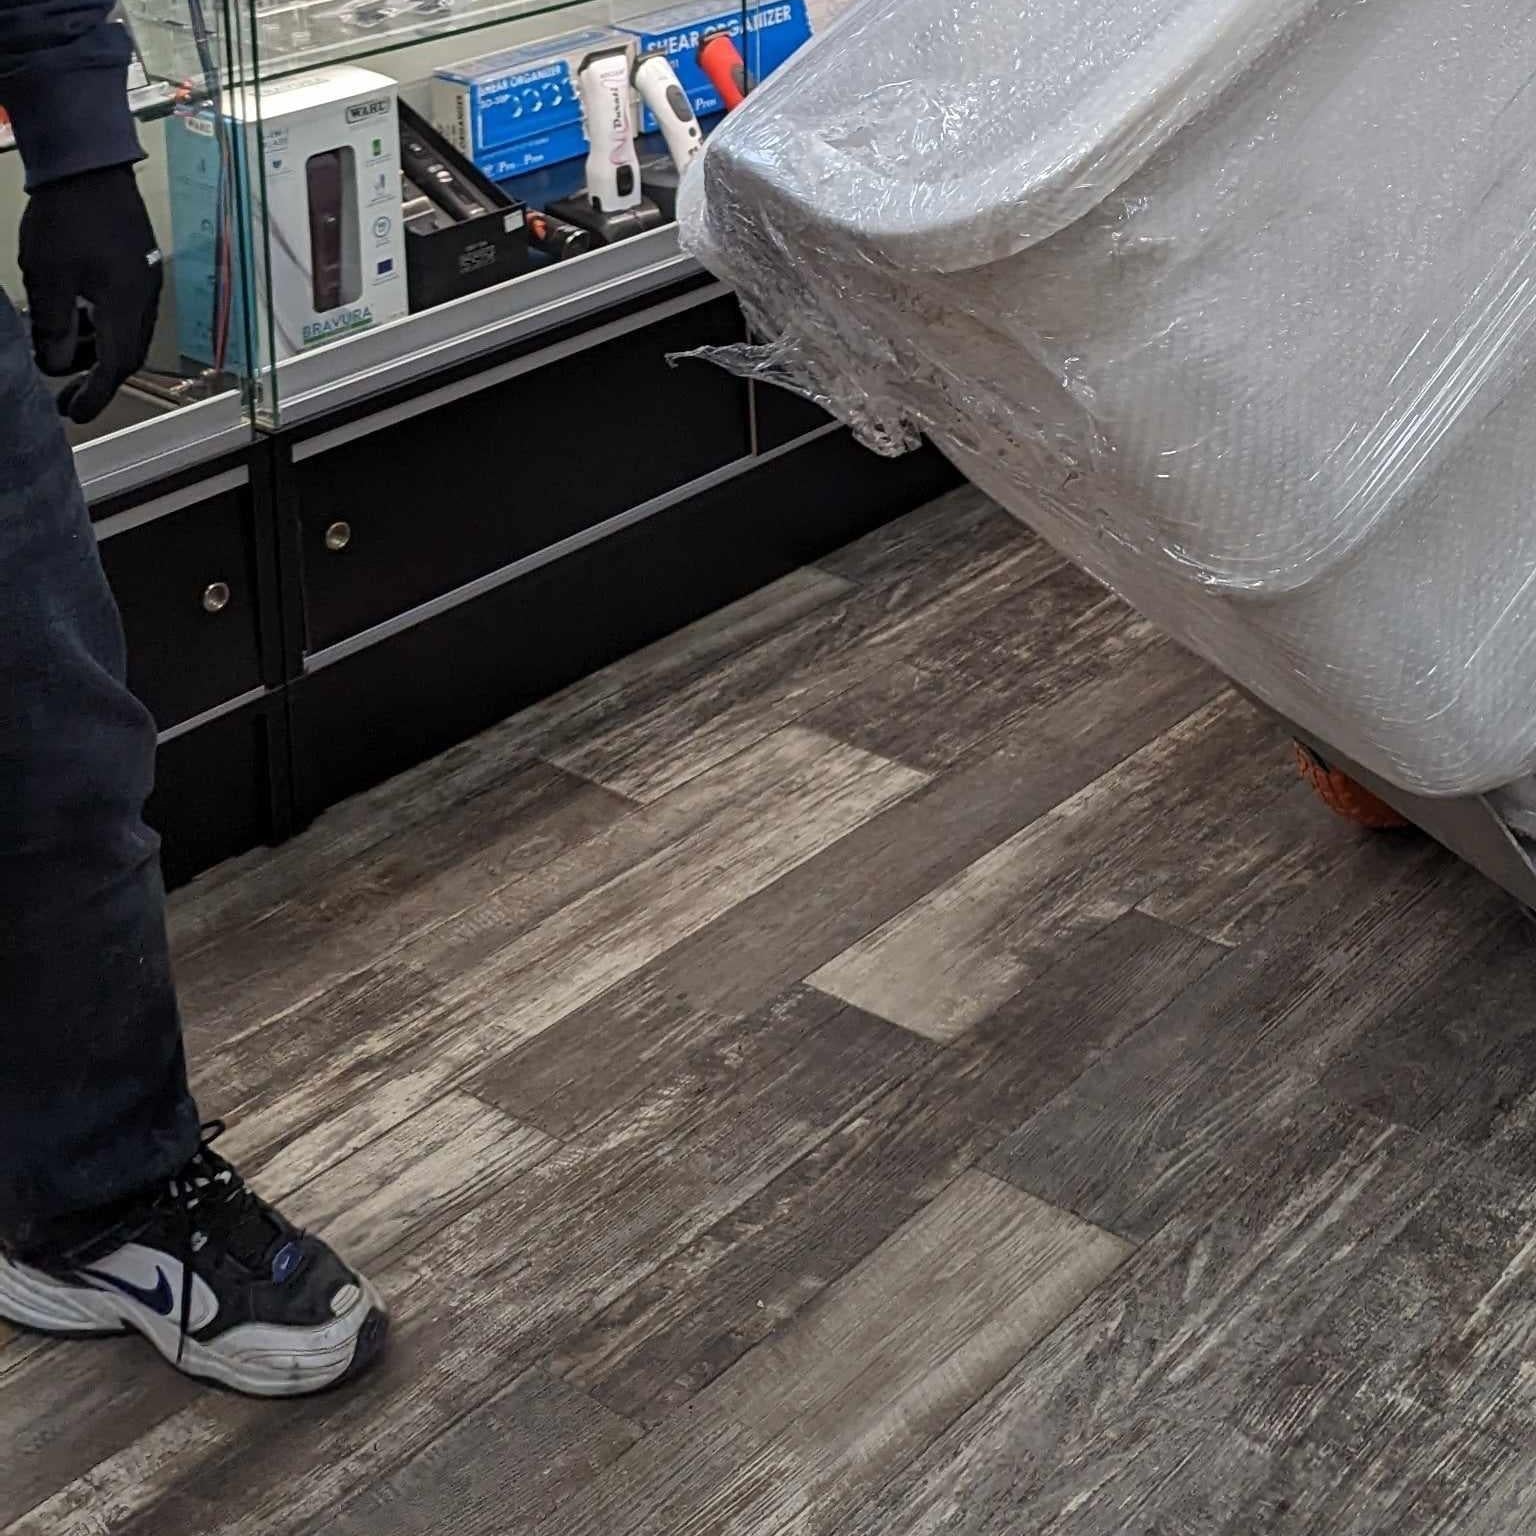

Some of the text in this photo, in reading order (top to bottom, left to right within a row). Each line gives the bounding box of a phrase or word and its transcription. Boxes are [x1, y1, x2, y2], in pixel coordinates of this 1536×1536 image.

[648, 31, 699, 54] SHEAR
[510, 65, 562, 87] ORGANIZER
[304, 306, 372, 338] BRAVURA
